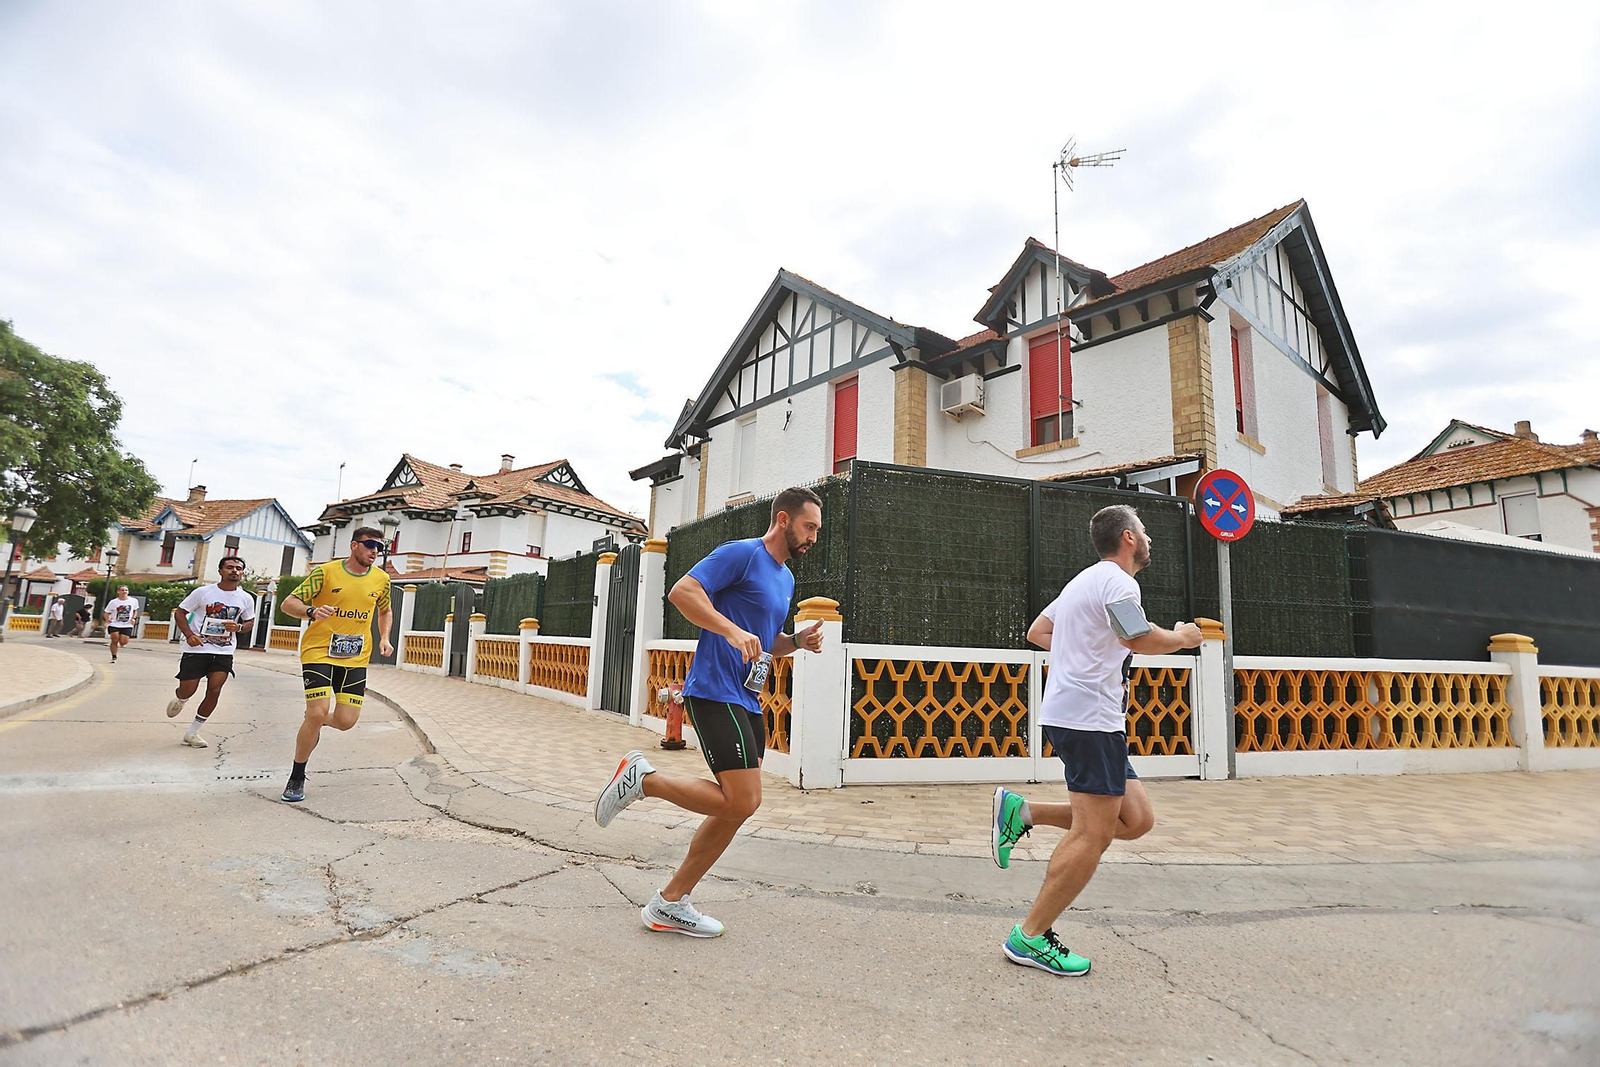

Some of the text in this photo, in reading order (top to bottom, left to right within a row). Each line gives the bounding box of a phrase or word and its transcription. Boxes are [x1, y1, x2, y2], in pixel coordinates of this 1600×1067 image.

[331, 607, 369, 620] Huelva
[335, 641, 360, 654] 143
[656, 908, 697, 928] new balance
